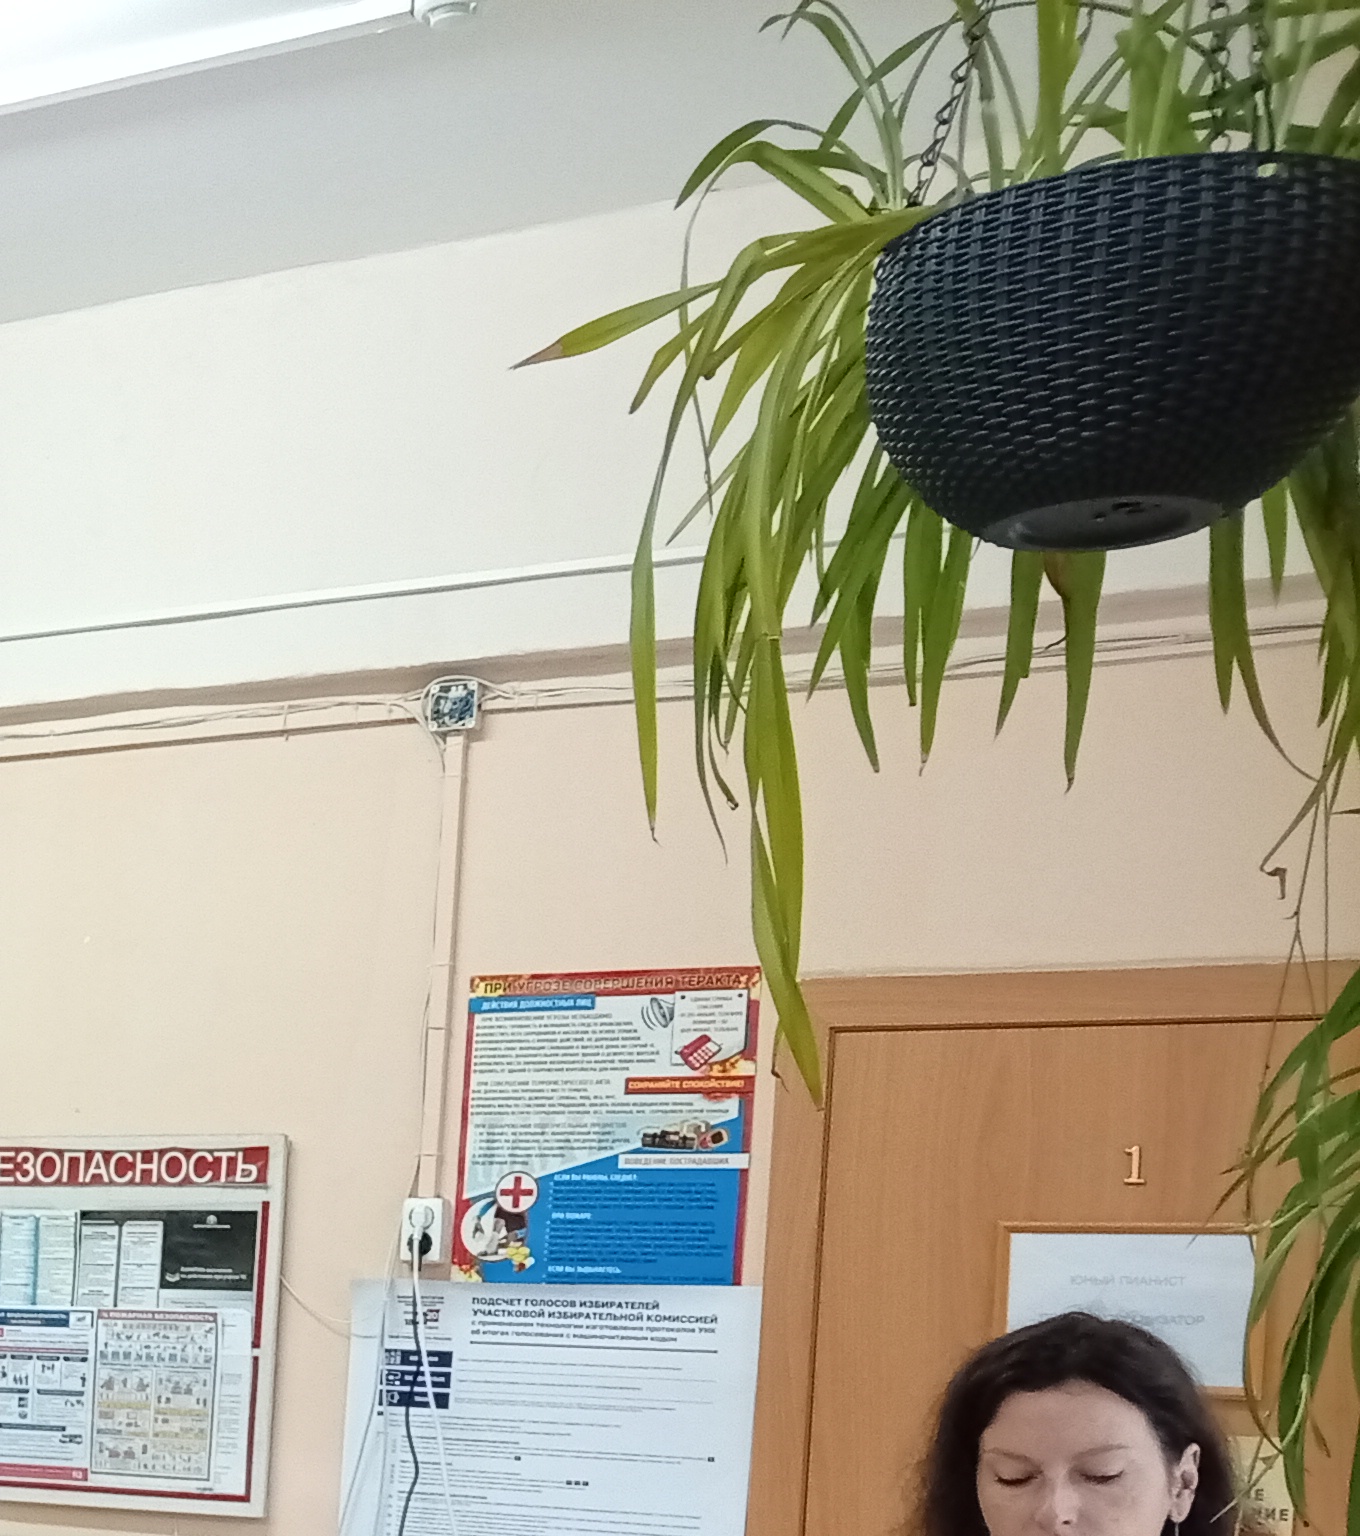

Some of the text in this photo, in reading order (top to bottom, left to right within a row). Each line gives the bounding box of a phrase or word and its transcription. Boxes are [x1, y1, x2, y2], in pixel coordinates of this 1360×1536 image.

[484, 974, 741, 994] ПРИ УГРОЗЕ СОВЕРШЕНИЯ ТЕРАКТА
[1123, 1145, 1146, 1186] 1
[1120, 1275, 1186, 1287] ПИАНИСТ
[471, 1297, 660, 1311] ПОДСЧЕТ ГОЛОСОВ ИЗБИРАТЕЛЕЙ
[471, 1308, 718, 1325] УЧАСТКОВОЙ ИЗБИРАТЕЛЬНОЙ КОМИССИЕЙ
